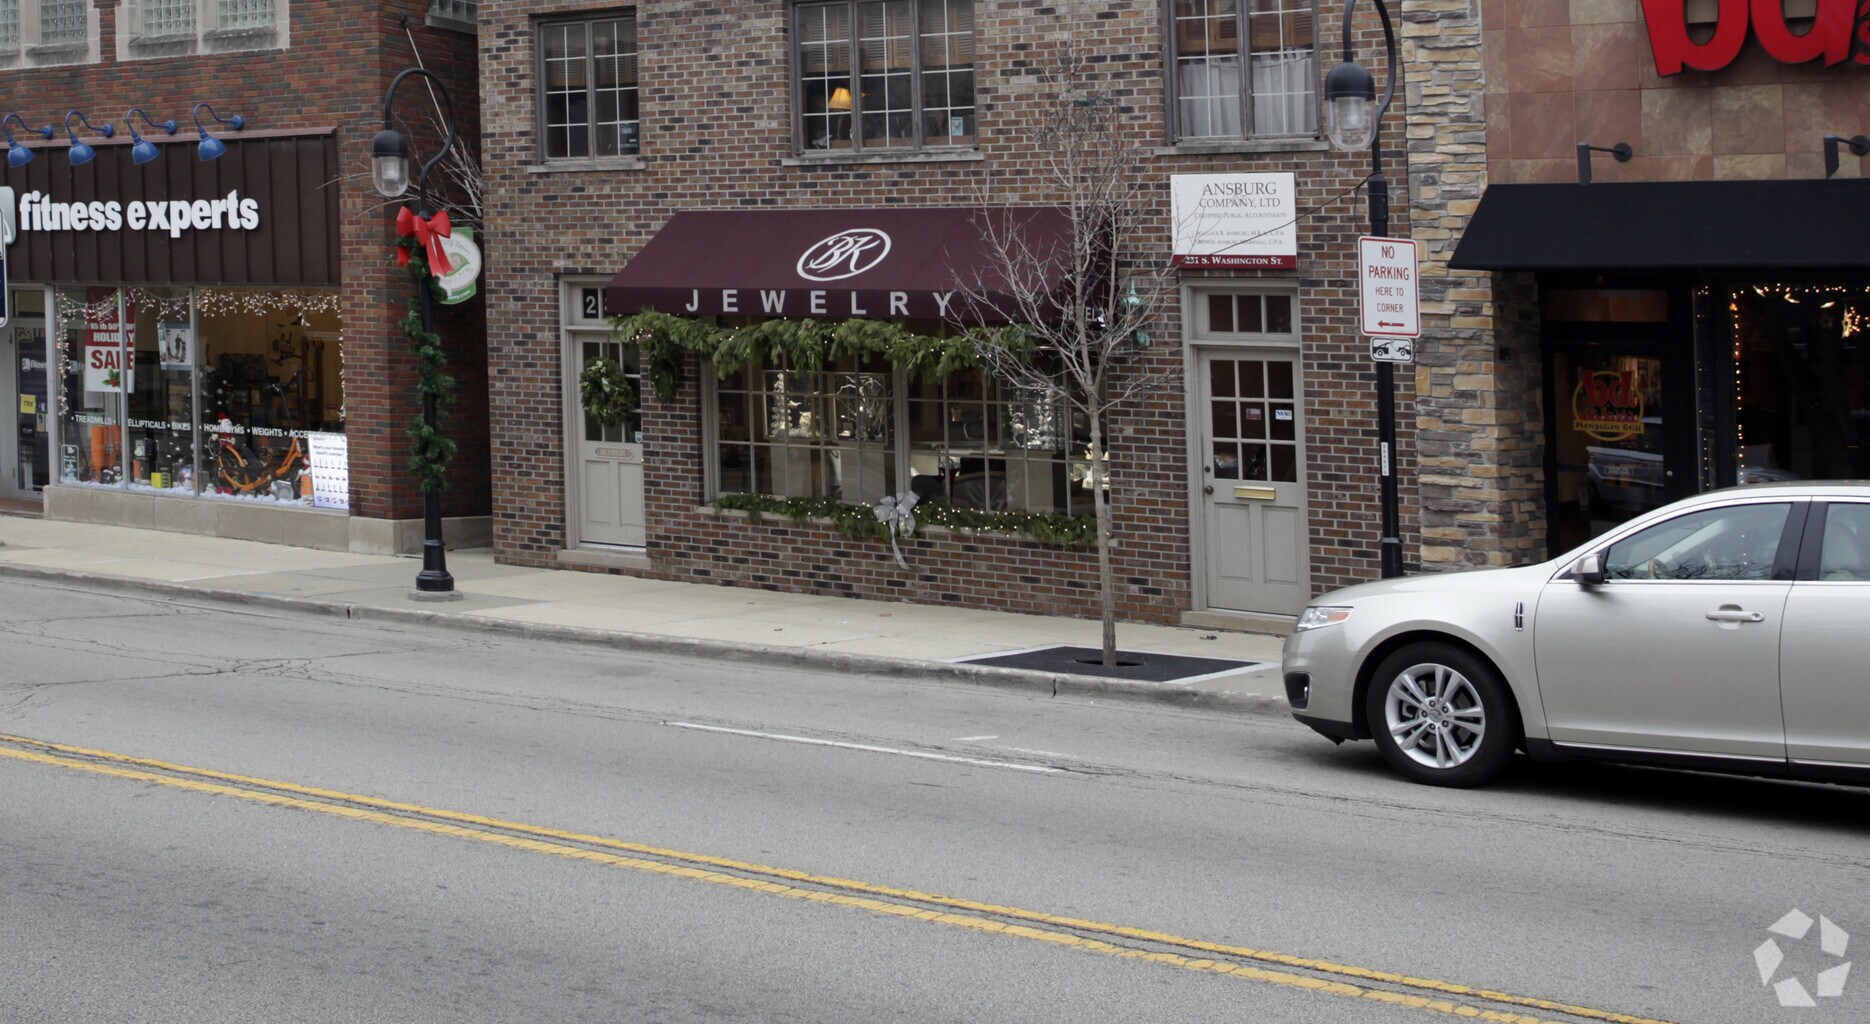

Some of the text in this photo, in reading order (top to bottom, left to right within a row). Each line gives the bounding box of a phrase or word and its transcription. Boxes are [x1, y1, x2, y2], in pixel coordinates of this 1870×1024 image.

[1202, 181, 1277, 196] ANSBURG
[1199, 197, 1281, 209] COMPANY, LTD
[20, 189, 260, 238] fitness experts
[1381, 245, 1395, 259] NO
[1201, 256, 1210, 265] S.
[1211, 256, 1269, 265] WASHINGTON
[1368, 265, 1410, 281] PARKING
[1375, 286, 1404, 297] HERE TO
[685, 288, 953, 317] JEWELRY
[1376, 302, 1404, 313] CORNER
[107, 322, 119, 330] 50
[93, 332, 134, 343] HOLIDY
[90, 349, 134, 370] SALE
[75, 414, 112, 425] TREADMILLS
[128, 418, 166, 430] ELLIPTICALS
[171, 421, 191, 431] BIKES
[252, 427, 283, 437] WEIGHTS
[1575, 420, 1641, 432] Mongolian Grill
